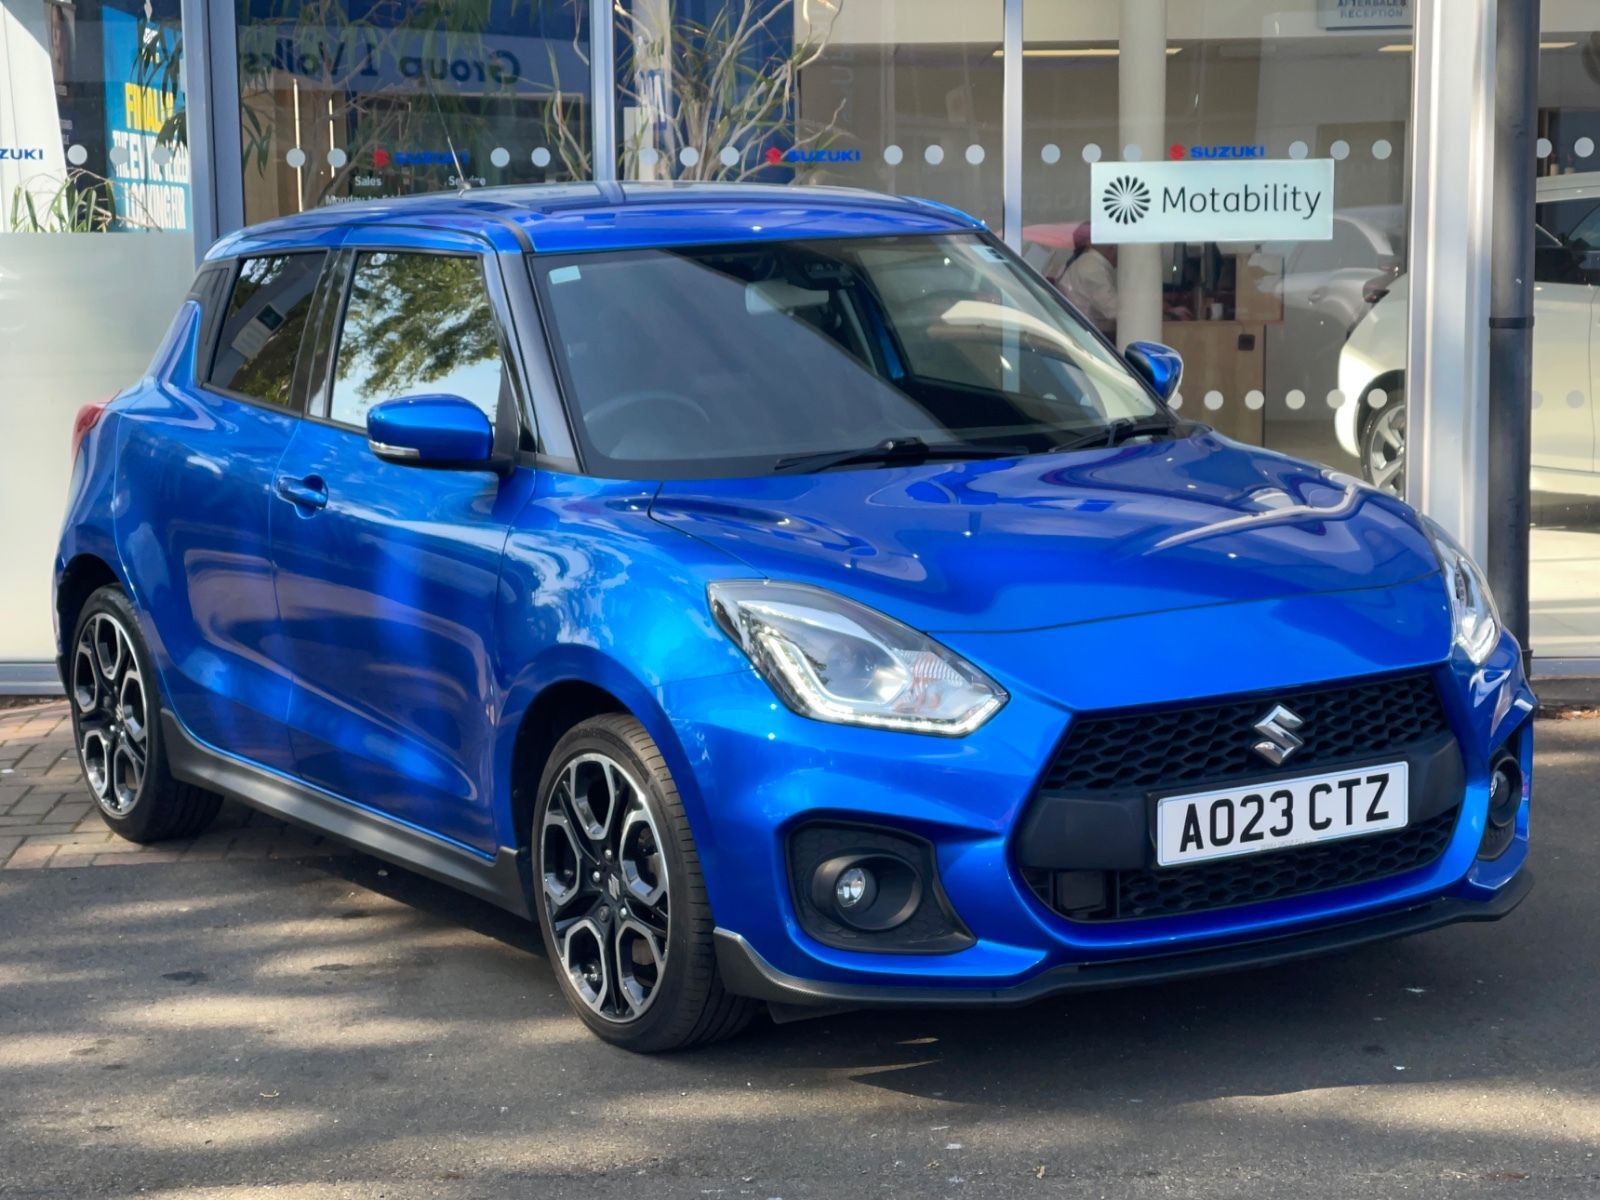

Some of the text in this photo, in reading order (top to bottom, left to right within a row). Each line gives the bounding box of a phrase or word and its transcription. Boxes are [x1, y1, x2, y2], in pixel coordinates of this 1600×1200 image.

[1340, 8, 1403, 18] RECEPTION
[0, 148, 44, 160] ZUKI
[1190, 144, 1265, 159] SUZUKI
[354, 175, 383, 187] Sales
[1162, 184, 1321, 220] Motability
[1308, 773, 1390, 831] CTZ
